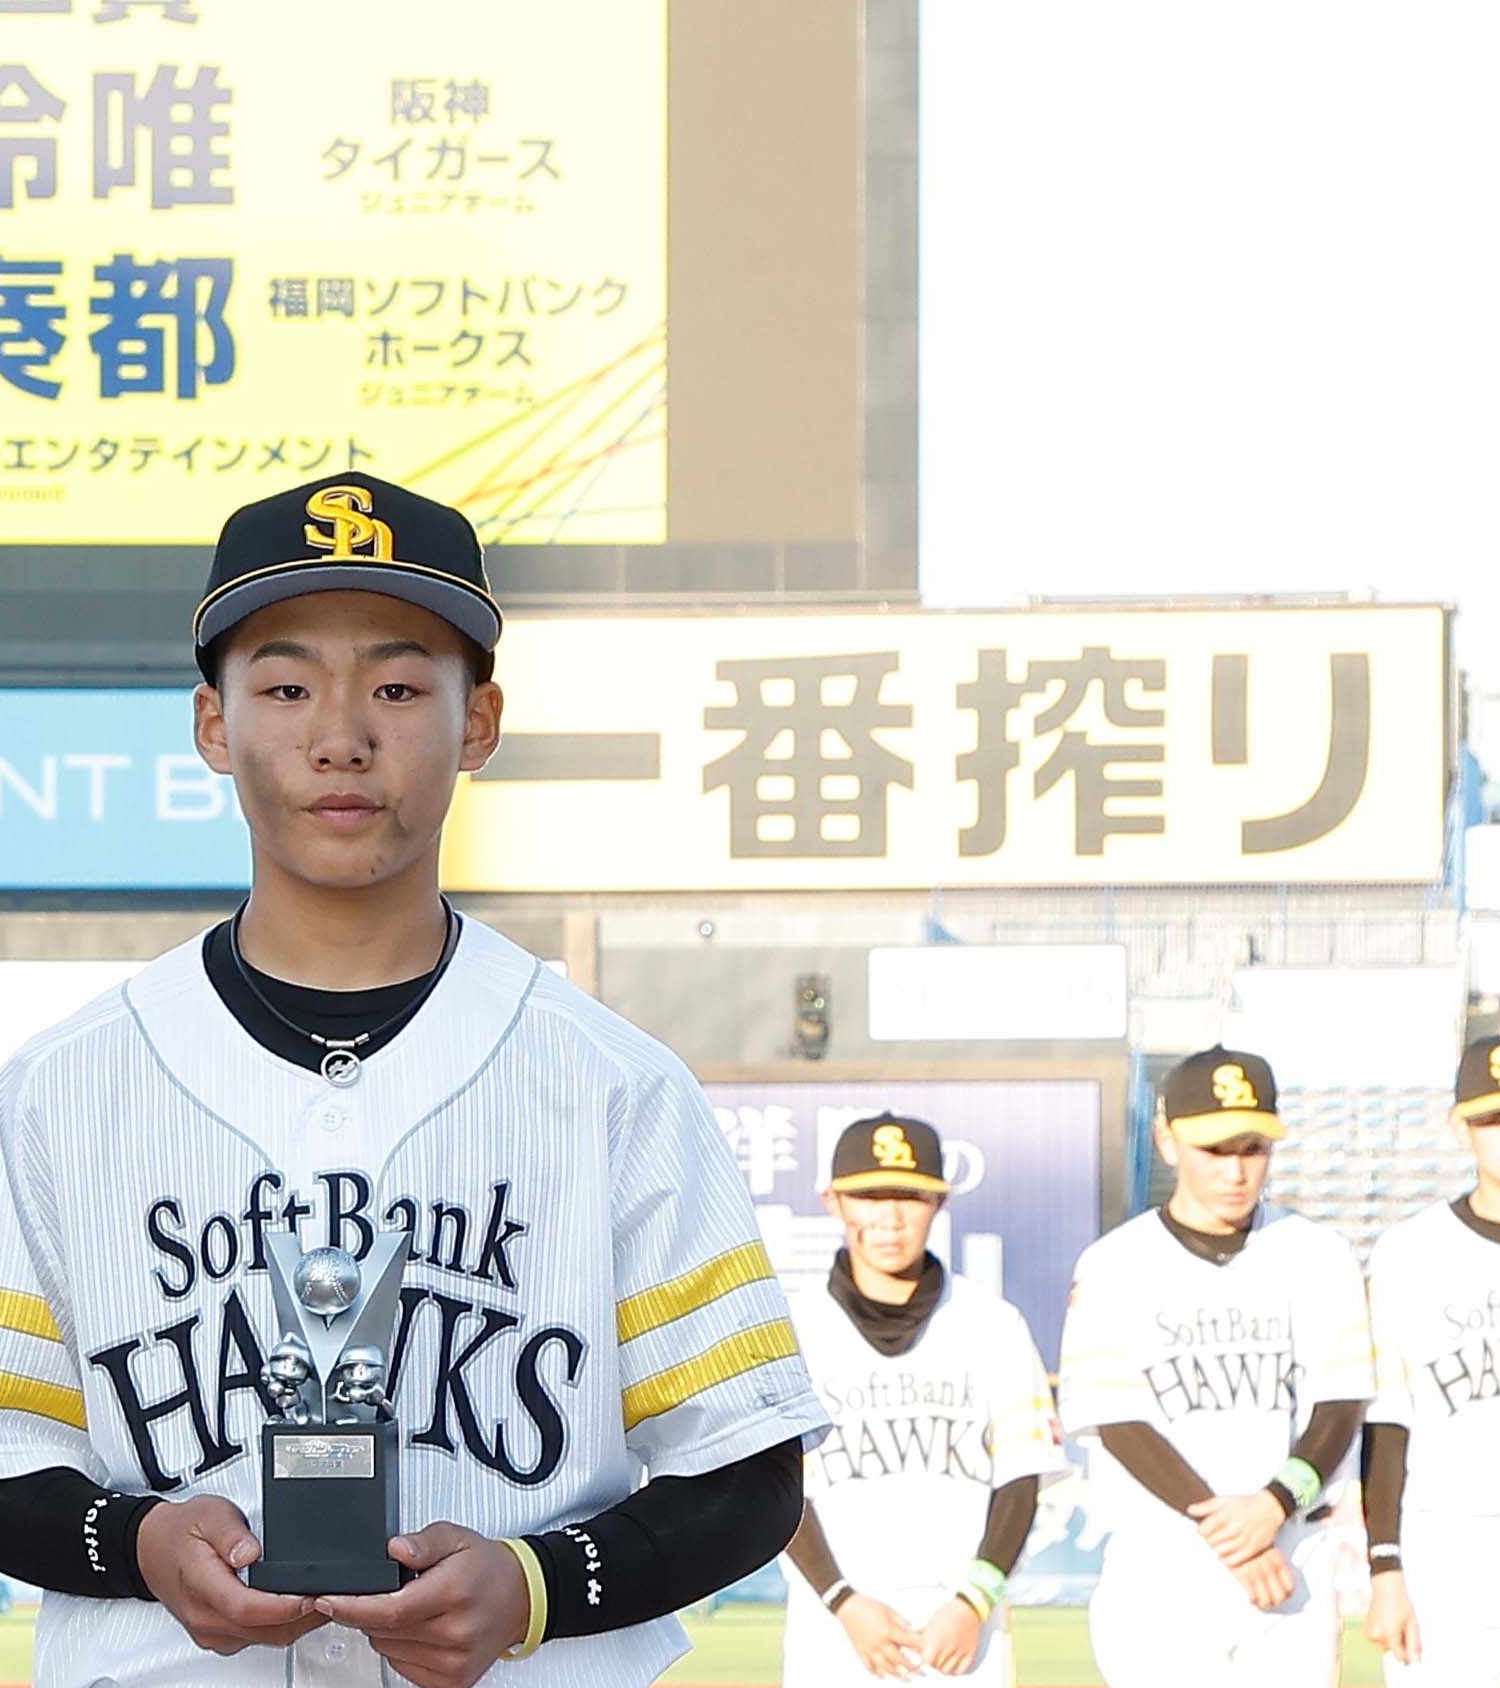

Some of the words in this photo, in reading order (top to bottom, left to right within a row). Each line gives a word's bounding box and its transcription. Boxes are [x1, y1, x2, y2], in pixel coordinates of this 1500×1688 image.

[392, 79, 491, 124] 阪神
[321, 137, 560, 181] タイガース
[269, 277, 627, 317] 福岡ソフトバンク
[367, 331, 532, 367] ホークス
[470, 645, 1370, 859] 一番搾り
